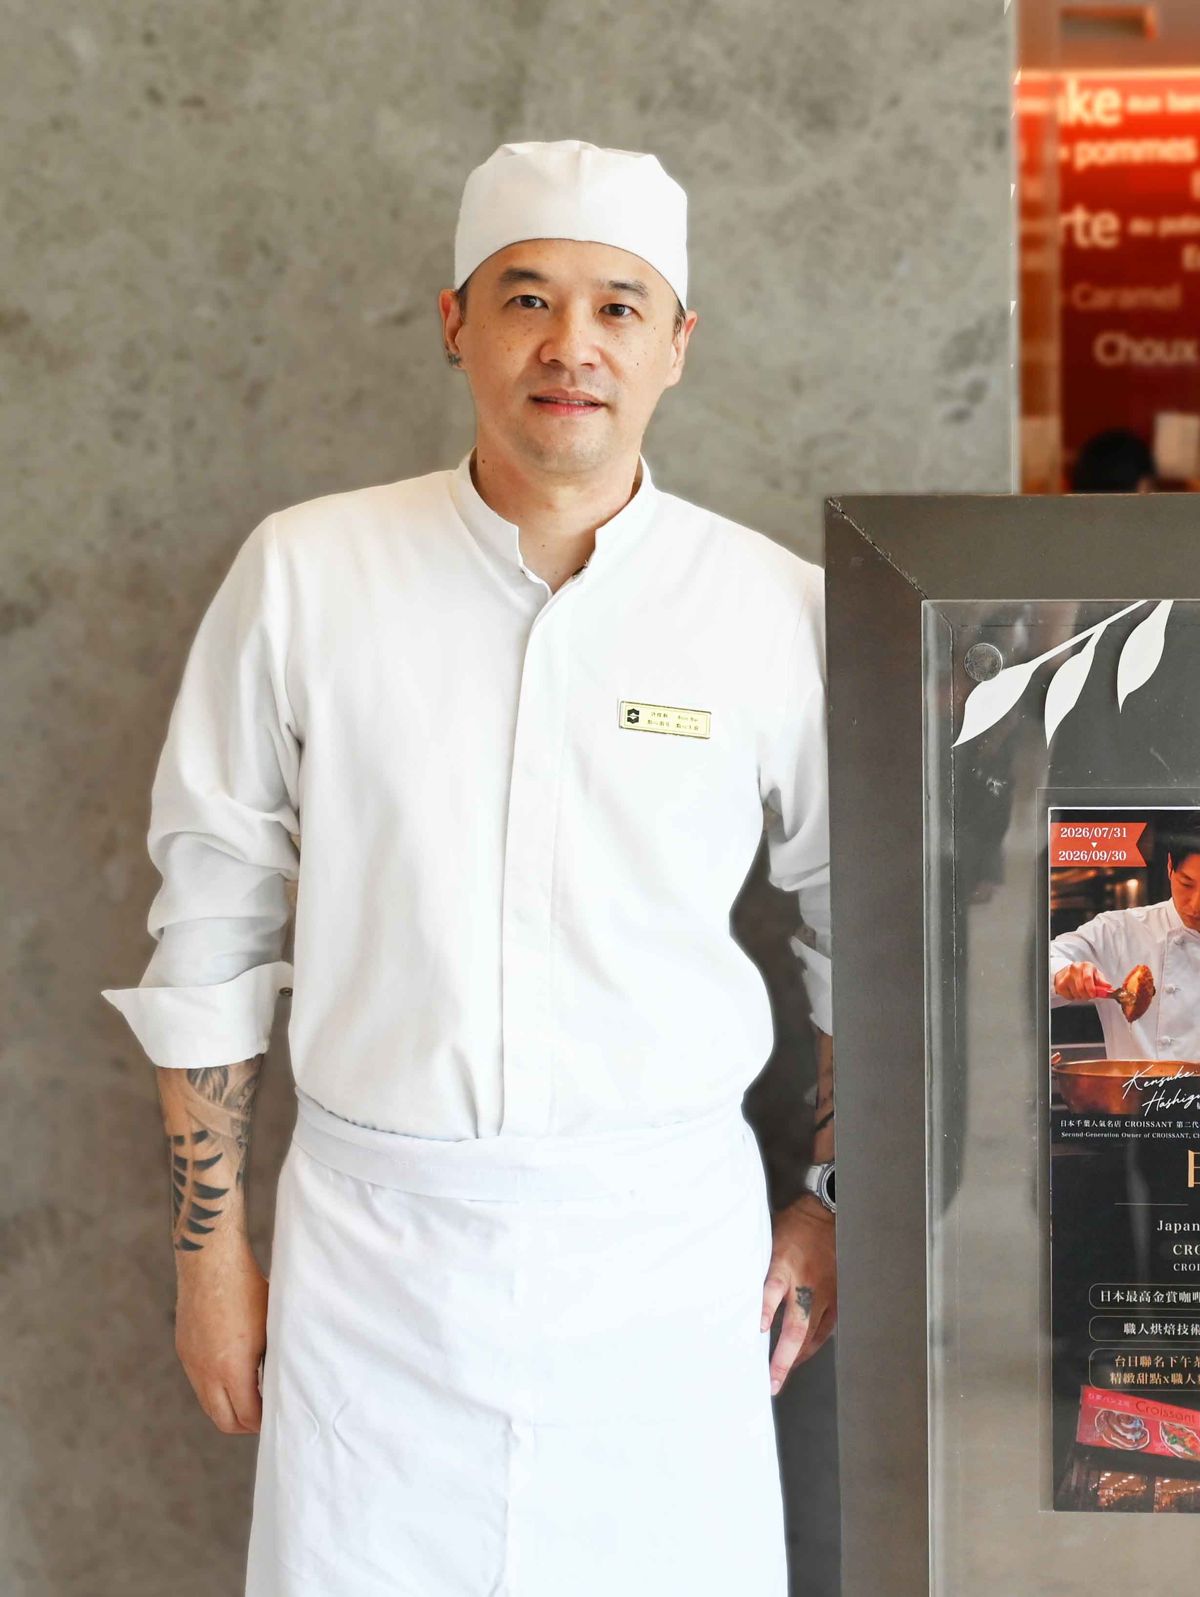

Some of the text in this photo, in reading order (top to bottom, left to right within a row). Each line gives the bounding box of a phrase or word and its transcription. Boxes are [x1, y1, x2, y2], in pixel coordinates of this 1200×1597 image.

[1072, 282, 1182, 311] Caramel
[1095, 333, 1198, 366] Choux
[1060, 827, 1128, 839] 2026/07/31
[1058, 850, 1127, 862] 2026/09/30
[1124, 1120, 1173, 1128] CROISSANT
